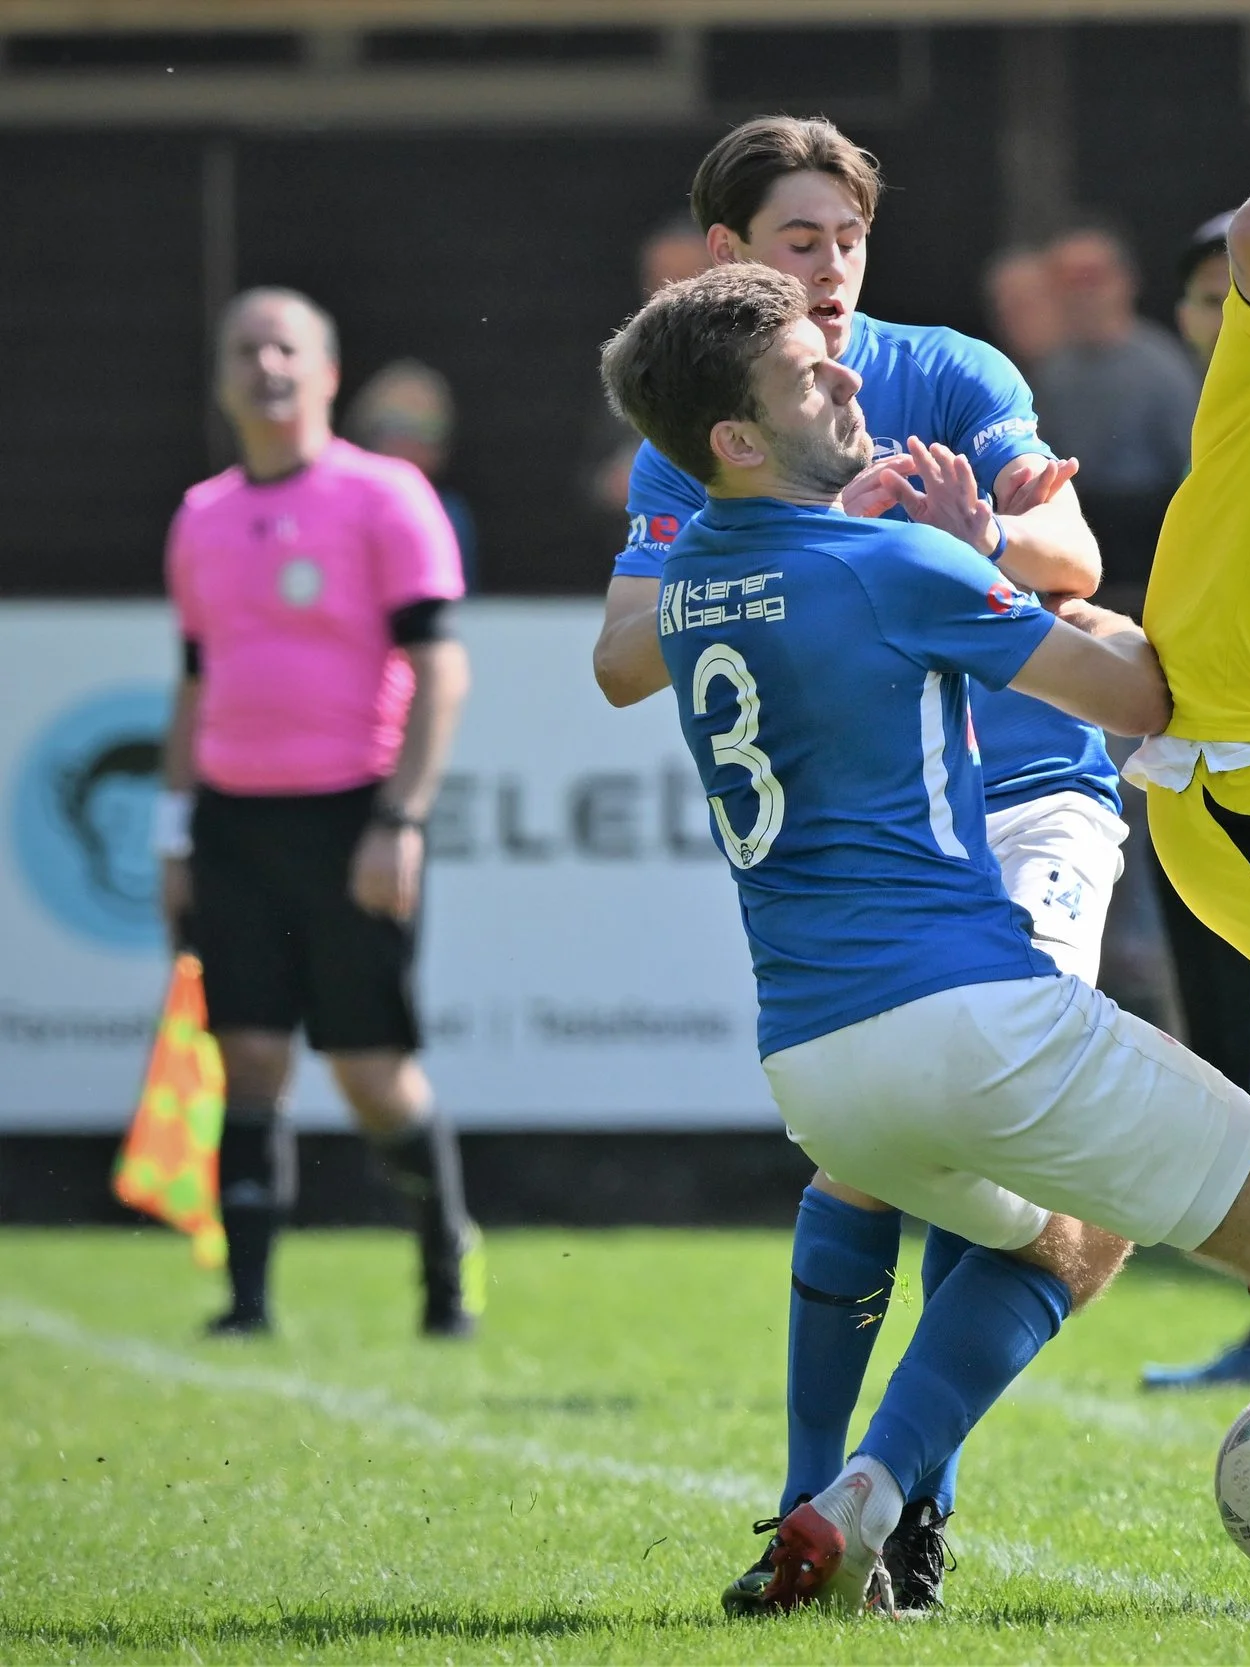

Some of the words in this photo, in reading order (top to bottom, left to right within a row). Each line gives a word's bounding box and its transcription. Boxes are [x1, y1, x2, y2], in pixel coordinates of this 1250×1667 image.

[685, 571, 784, 603] kiener
[685, 603, 742, 629] bau
[745, 595, 786, 622] ag
[692, 643, 785, 870] 3
